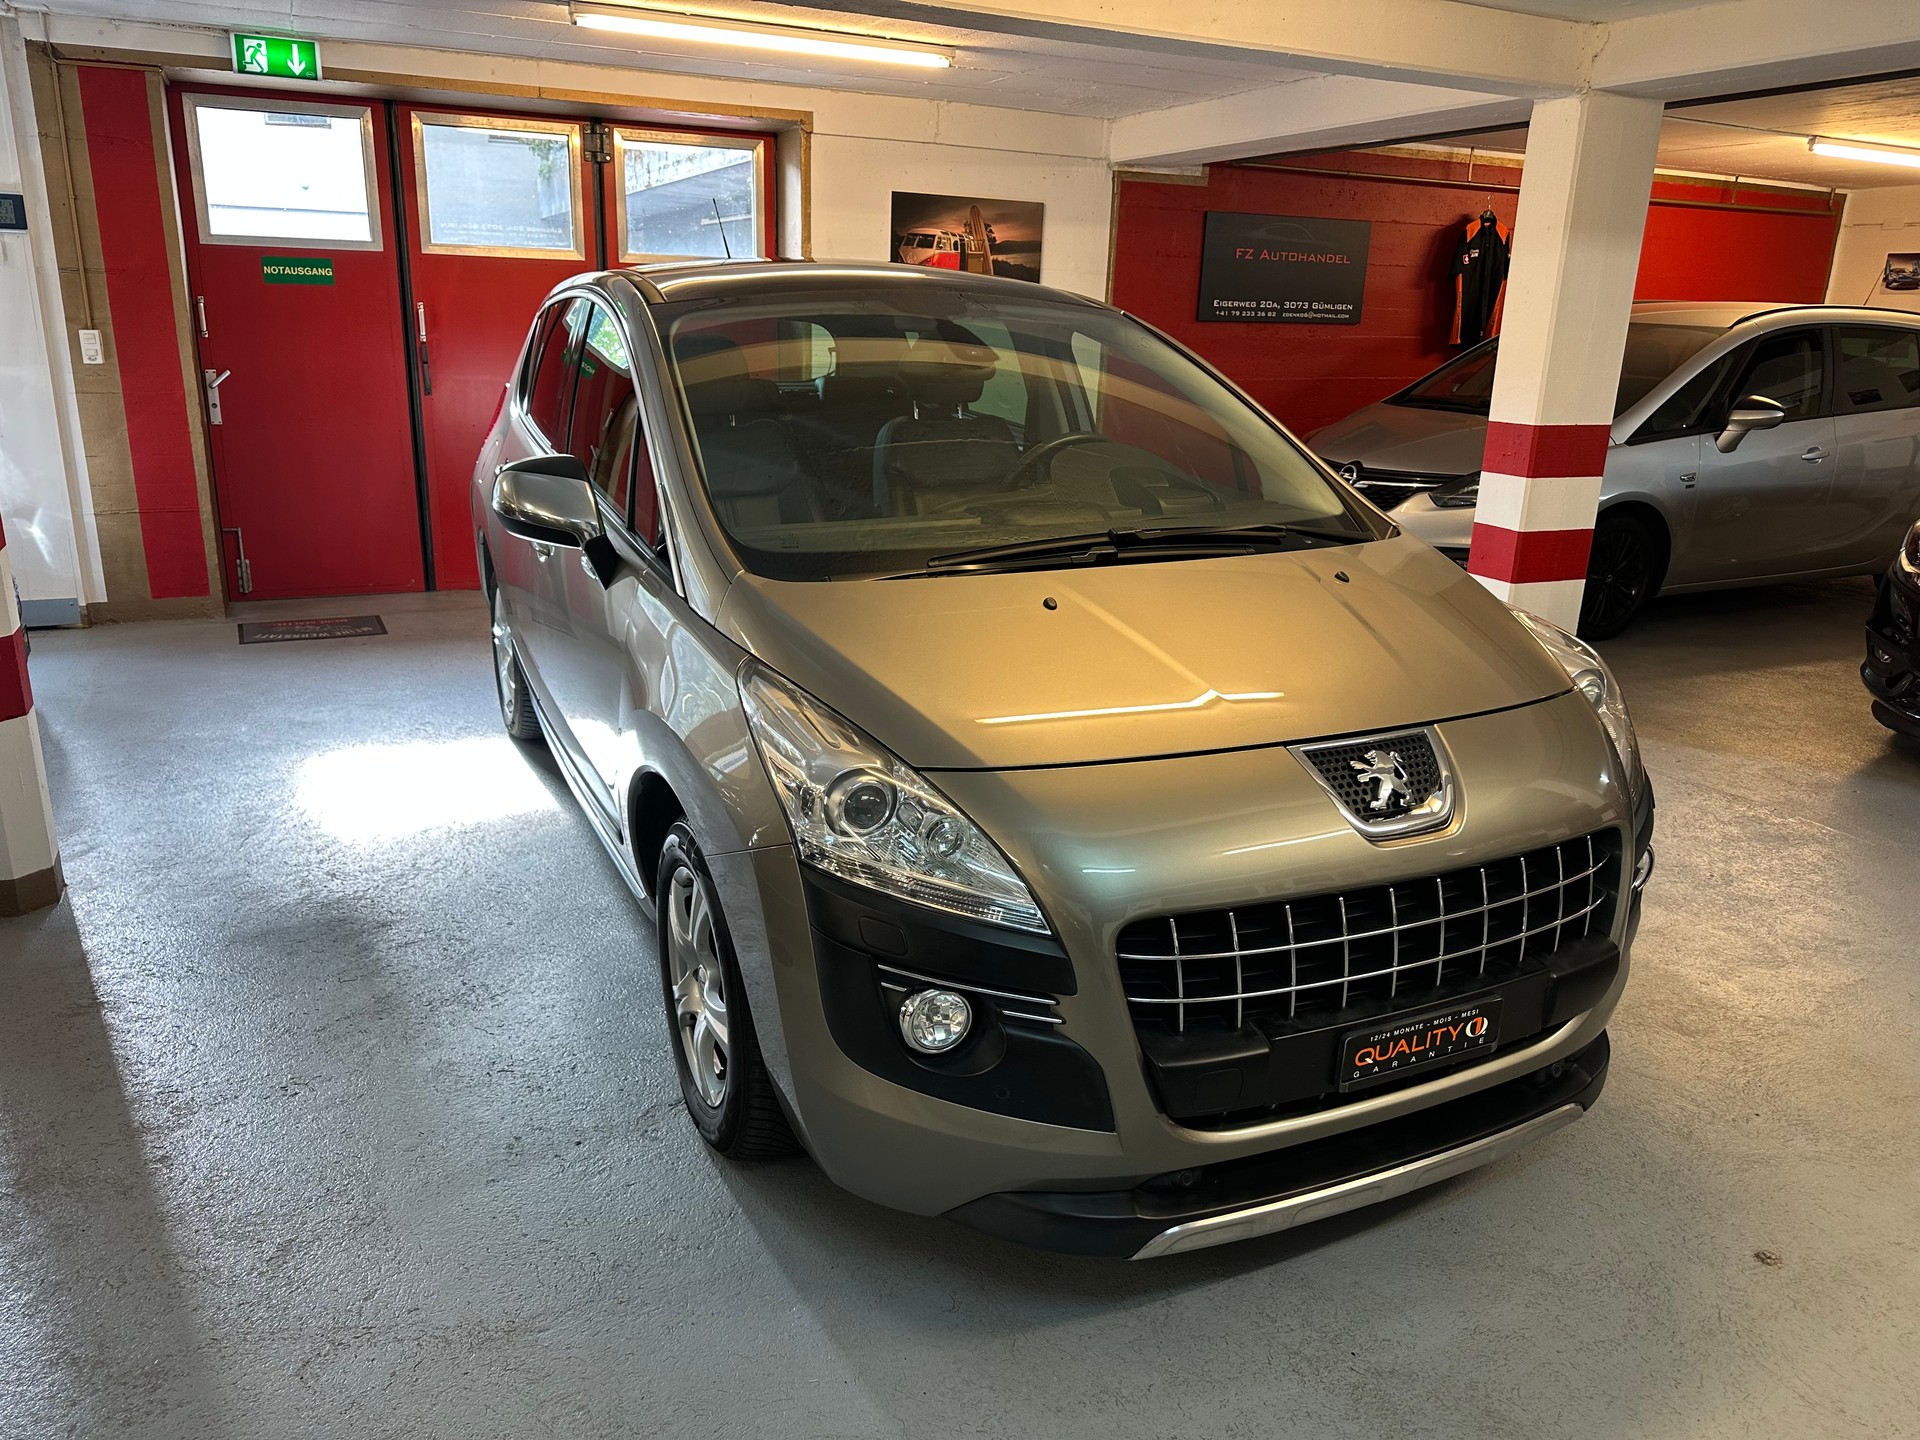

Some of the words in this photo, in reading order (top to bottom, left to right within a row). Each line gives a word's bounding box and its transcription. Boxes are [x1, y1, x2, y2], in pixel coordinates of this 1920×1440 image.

[1236, 248, 1255, 260] FZ
[1259, 249, 1351, 264] AUTOHANDEL
[263, 265, 333, 276] NOTAUSGANG
[1213, 299, 1257, 308] EIGERWEG
[1283, 301, 1309, 309] 3073
[1312, 301, 1353, 310] GÜMLIGEN
[1370, 1032, 1391, 1042] 12/24
[1394, 1023, 1424, 1036] MONATE
[1433, 1015, 1452, 1026] MOIS
[1461, 1009, 1479, 1018] MESI
[1354, 1022, 1464, 1067] QUALITY
[1353, 1037, 1485, 1078] GARANTIE
